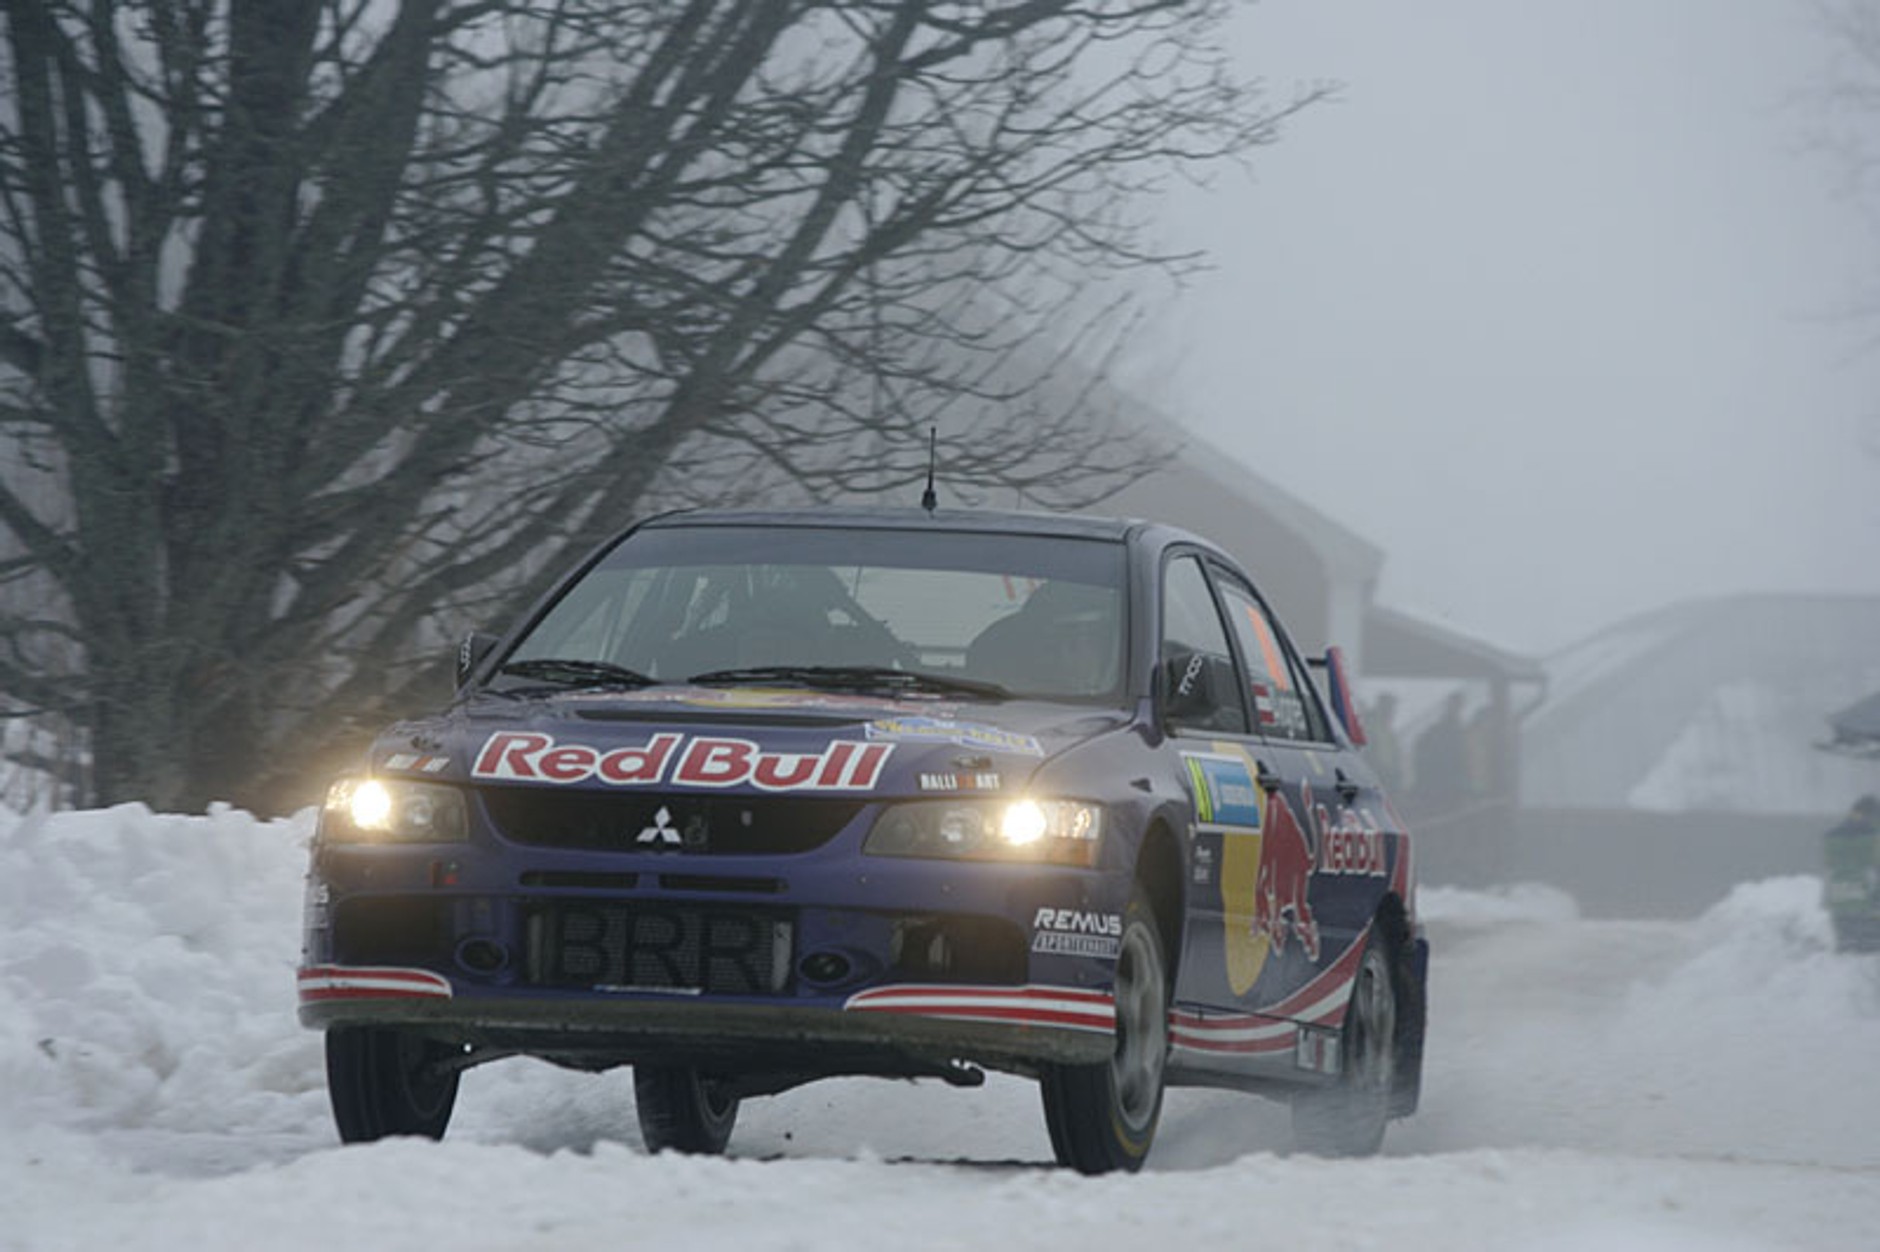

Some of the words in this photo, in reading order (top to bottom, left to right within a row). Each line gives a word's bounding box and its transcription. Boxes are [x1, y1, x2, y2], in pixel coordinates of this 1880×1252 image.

[471, 731, 684, 785] Red
[670, 736, 897, 792] Bull
[553, 904, 768, 989] BRR
[1033, 907, 1122, 936] REMUS
